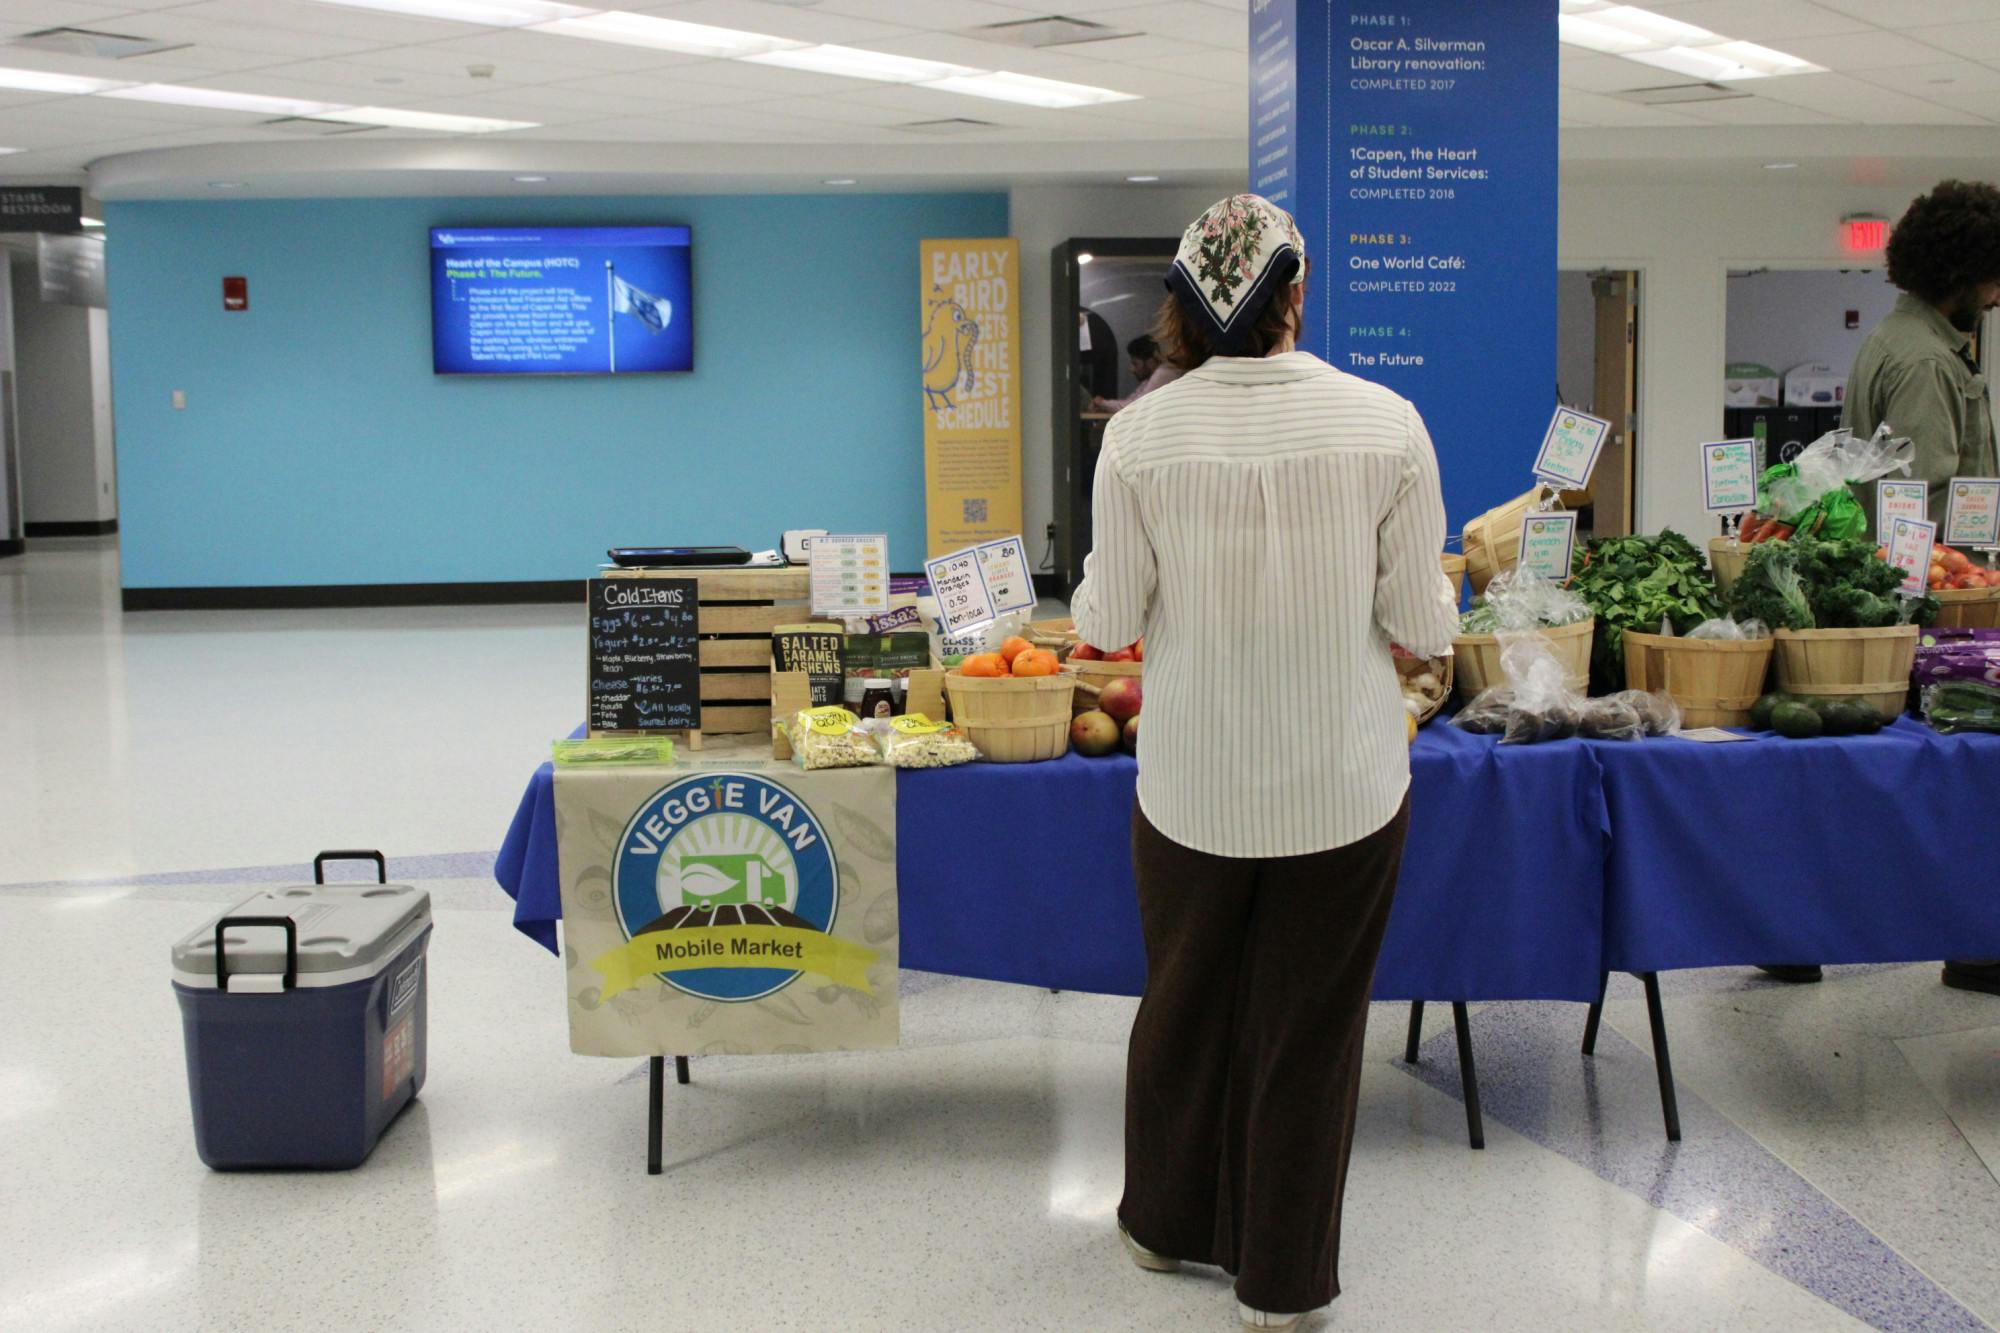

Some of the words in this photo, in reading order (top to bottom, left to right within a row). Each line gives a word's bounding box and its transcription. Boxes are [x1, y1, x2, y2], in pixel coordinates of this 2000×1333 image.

[1351, 15, 1395, 26] PHASE
[1401, 15, 1411, 26] 1:
[1351, 38, 1393, 51] Oscar
[1397, 38, 1411, 51] A.
[1415, 37, 1485, 51] Silverman
[1351, 57, 1400, 72] Library
[1405, 58, 1485, 70] renovation:
[1350, 79, 1426, 90] COMPLETED
[1430, 79, 1456, 90] 2017
[1350, 125, 1395, 136] PHASE
[1401, 125, 1412, 136] 2:
[1350, 148, 1406, 162] 1Capen,
[1411, 148, 1435, 161] the
[1438, 148, 1477, 161] Heart
[1350, 166, 1366, 179] of
[1368, 166, 1422, 179] Student
[1427, 166, 1489, 179] Services:
[1350, 188, 1426, 200] COMPLETED
[1429, 188, 1456, 200] 2018
[1350, 233, 1395, 245] PHASE
[1400, 233, 1412, 245] 3:
[446, 258, 473, 268] Heart
[474, 258, 485, 268] of
[486, 258, 501, 268] the
[503, 258, 542, 270] Campus
[932, 250, 1009, 286] EARLY
[1350, 256, 1380, 270] One
[1383, 256, 1424, 270] World
[1428, 255, 1466, 270] Café:
[446, 269, 476, 278] Phase
[490, 269, 507, 278] The
[954, 276, 1008, 311] BIRD
[1350, 281, 1425, 292] COMPLETED
[1428, 281, 1456, 292] 2022
[976, 313, 1008, 341] GETS
[1350, 327, 1394, 337] PHASE
[1400, 327, 1412, 337] 4:
[972, 342, 1009, 371] THE
[1350, 353, 1376, 366] The
[1379, 353, 1424, 366] Future
[955, 372, 1011, 401] BEST
[936, 399, 1010, 431] SCHEDULE
[936, 573, 971, 585] Mandarin
[940, 580, 970, 593] Oranges
[604, 584, 640, 605] Cold
[640, 586, 683, 604] Items
[592, 616, 622, 633] Eggs
[592, 634, 629, 653] Yogurt
[781, 636, 839, 651] SALTED
[783, 650, 840, 663] CARAMEL
[785, 662, 841, 674] CASHEWS
[758, 787, 817, 851] VAN
[655, 938, 725, 960] Mobile
[730, 938, 803, 958] Market
